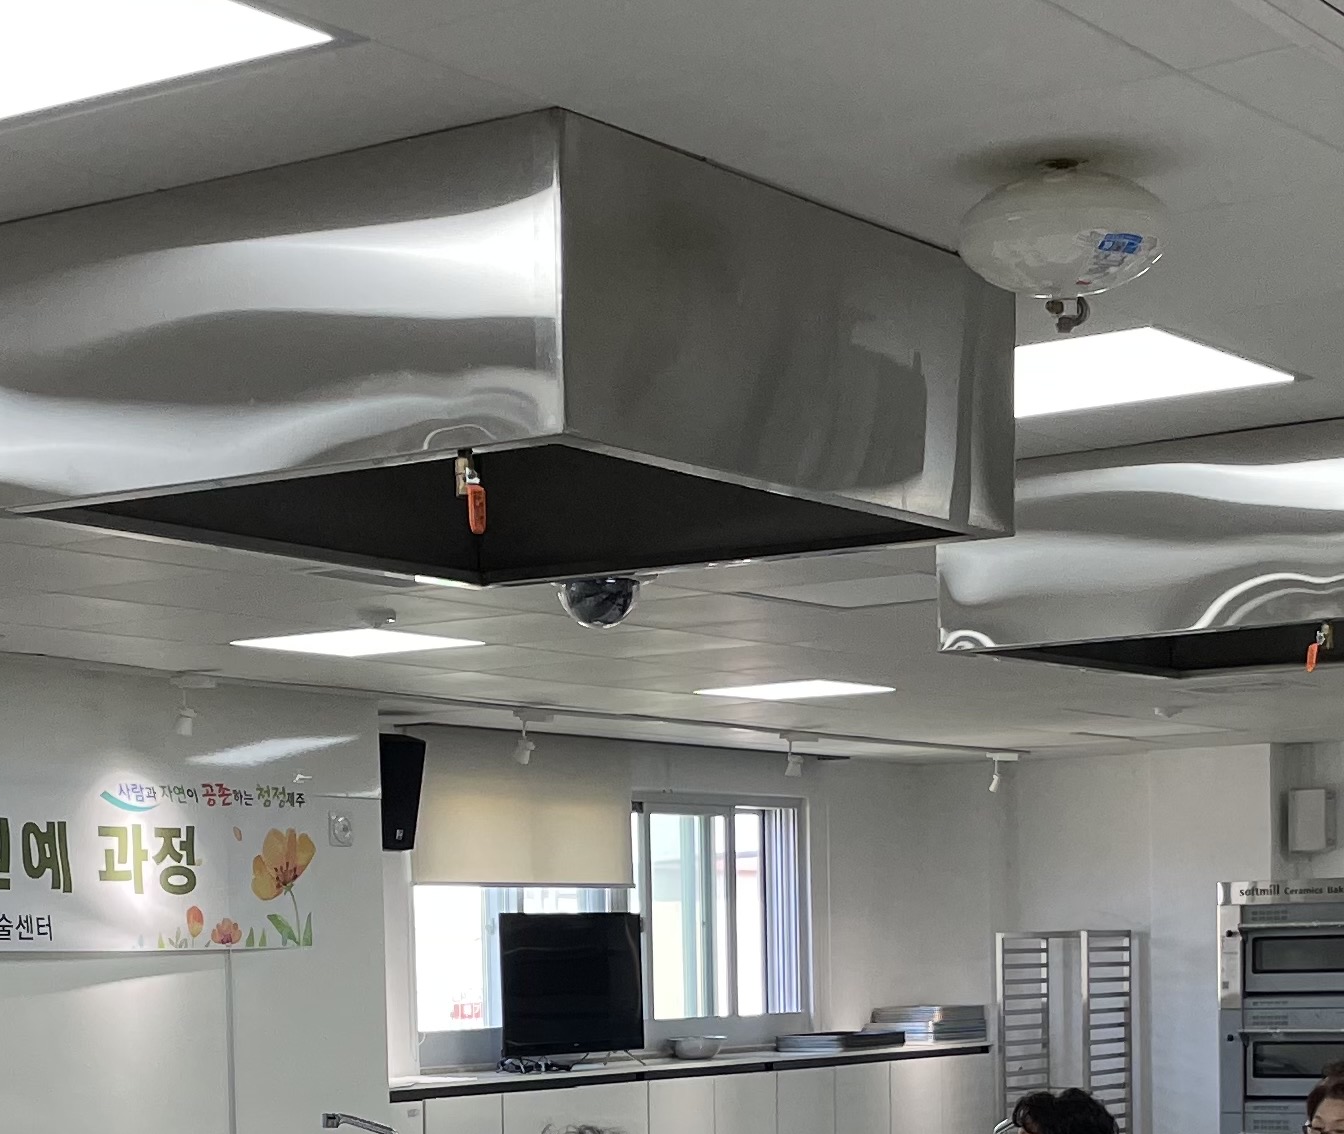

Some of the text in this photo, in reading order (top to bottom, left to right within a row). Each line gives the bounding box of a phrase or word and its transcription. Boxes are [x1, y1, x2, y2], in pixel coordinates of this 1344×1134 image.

[118, 783, 156, 801] 사람과
[161, 785, 199, 804] 자연이
[201, 783, 253, 807] 공존하는
[97, 822, 199, 896] 과정
[1239, 884, 1280, 897] softmill
[1284, 886, 1323, 895] Ceramics
